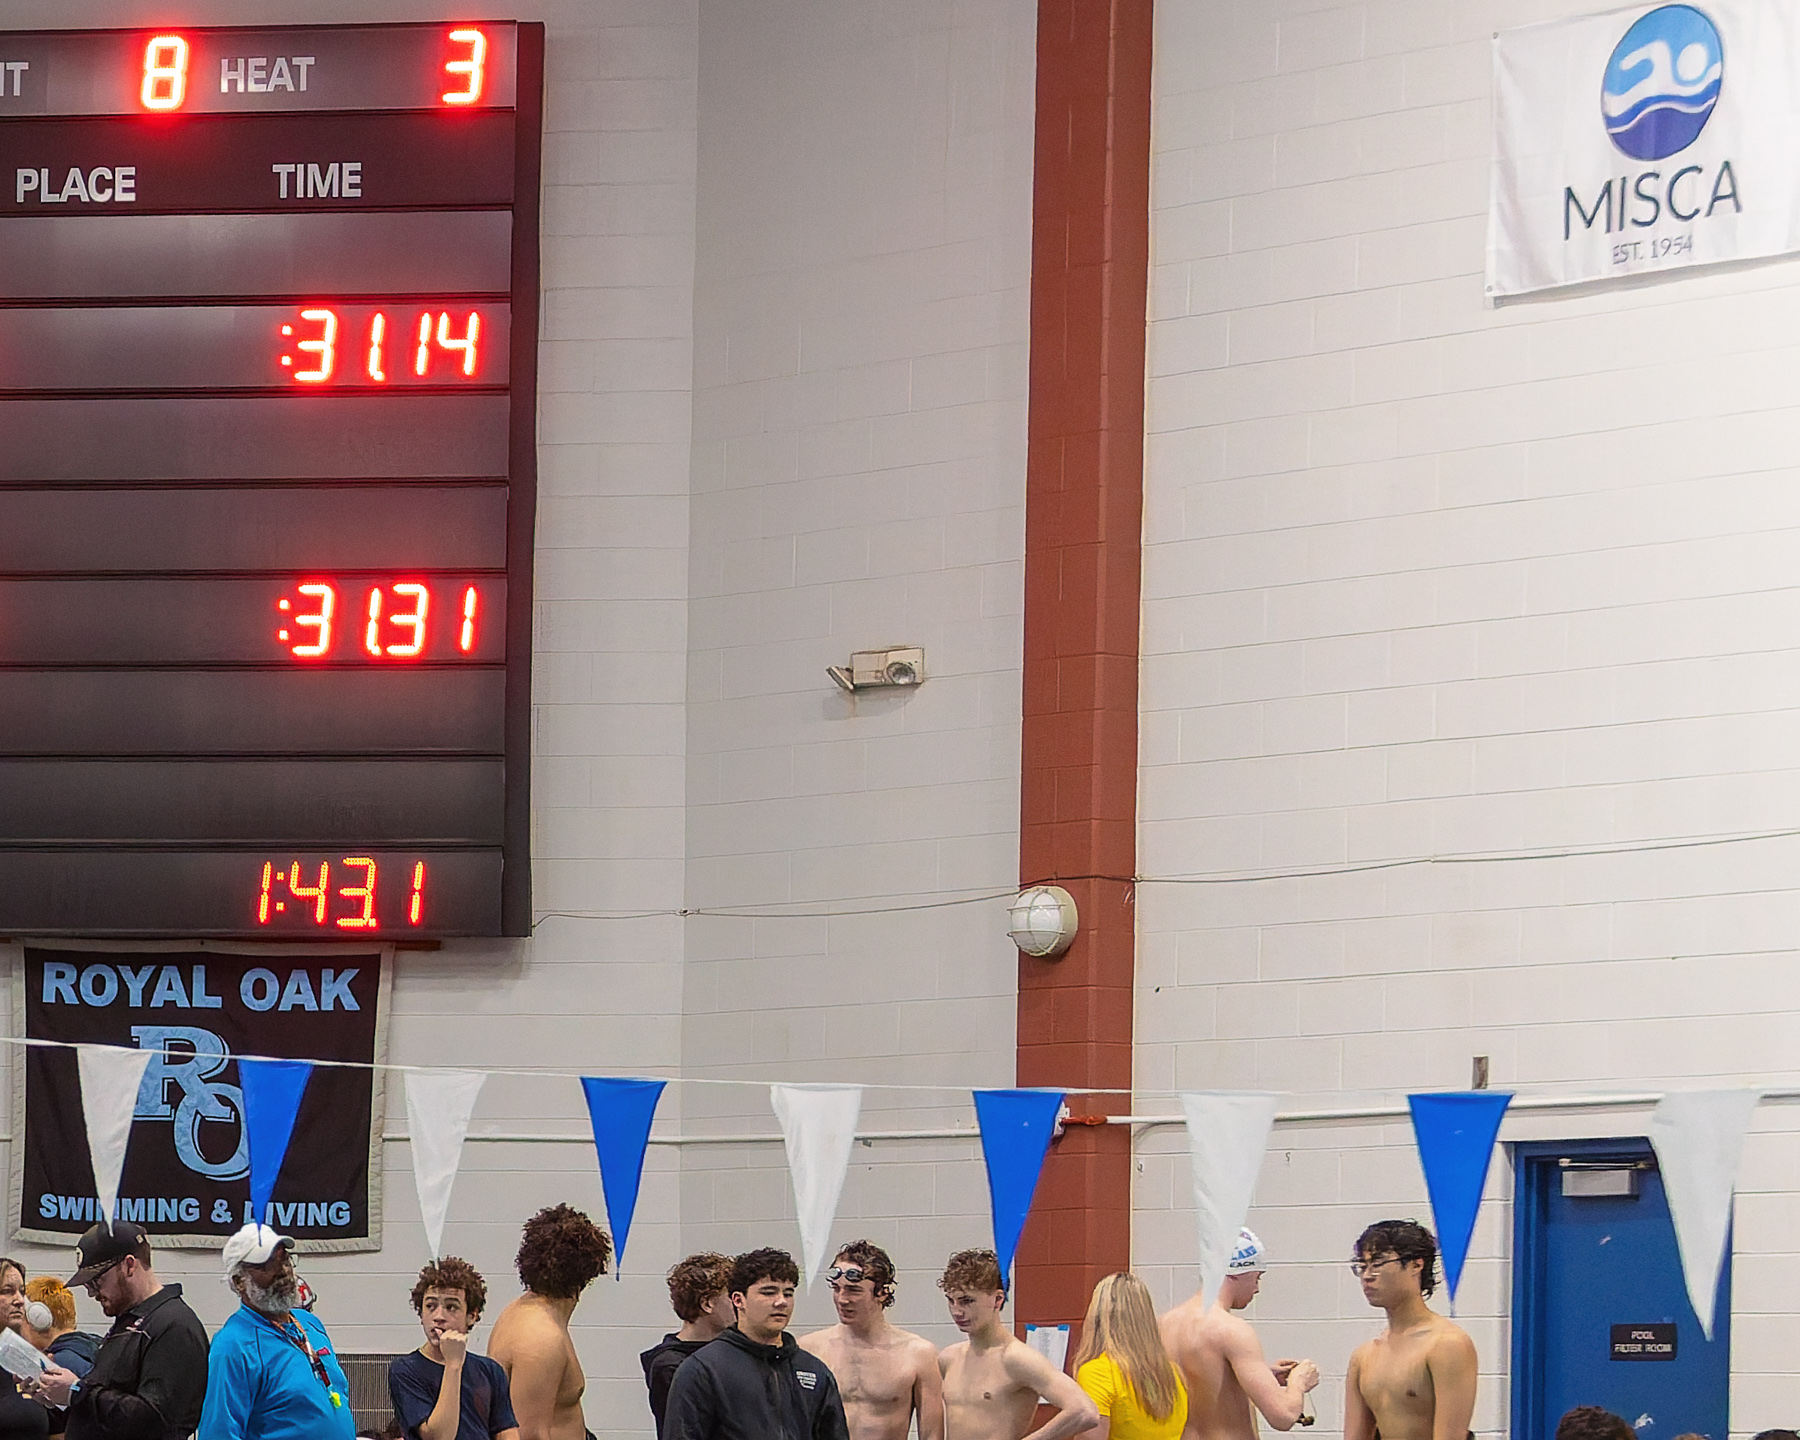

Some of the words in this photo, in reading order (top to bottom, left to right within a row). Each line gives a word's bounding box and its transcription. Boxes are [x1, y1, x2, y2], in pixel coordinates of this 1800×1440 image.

[141, 35, 189, 110] 8
[219, 57, 316, 93] HEAT
[442, 28, 486, 104] 3
[16, 167, 136, 203] PLACE
[272, 162, 363, 199] TIME
[1563, 160, 1743, 241] MISCA
[1612, 241, 1644, 265] EST.
[1650, 234, 1693, 260] 1954
[42, 962, 222, 1009] ROYAL
[239, 967, 361, 1012] OAK
[210, 1199, 233, 1224] &
